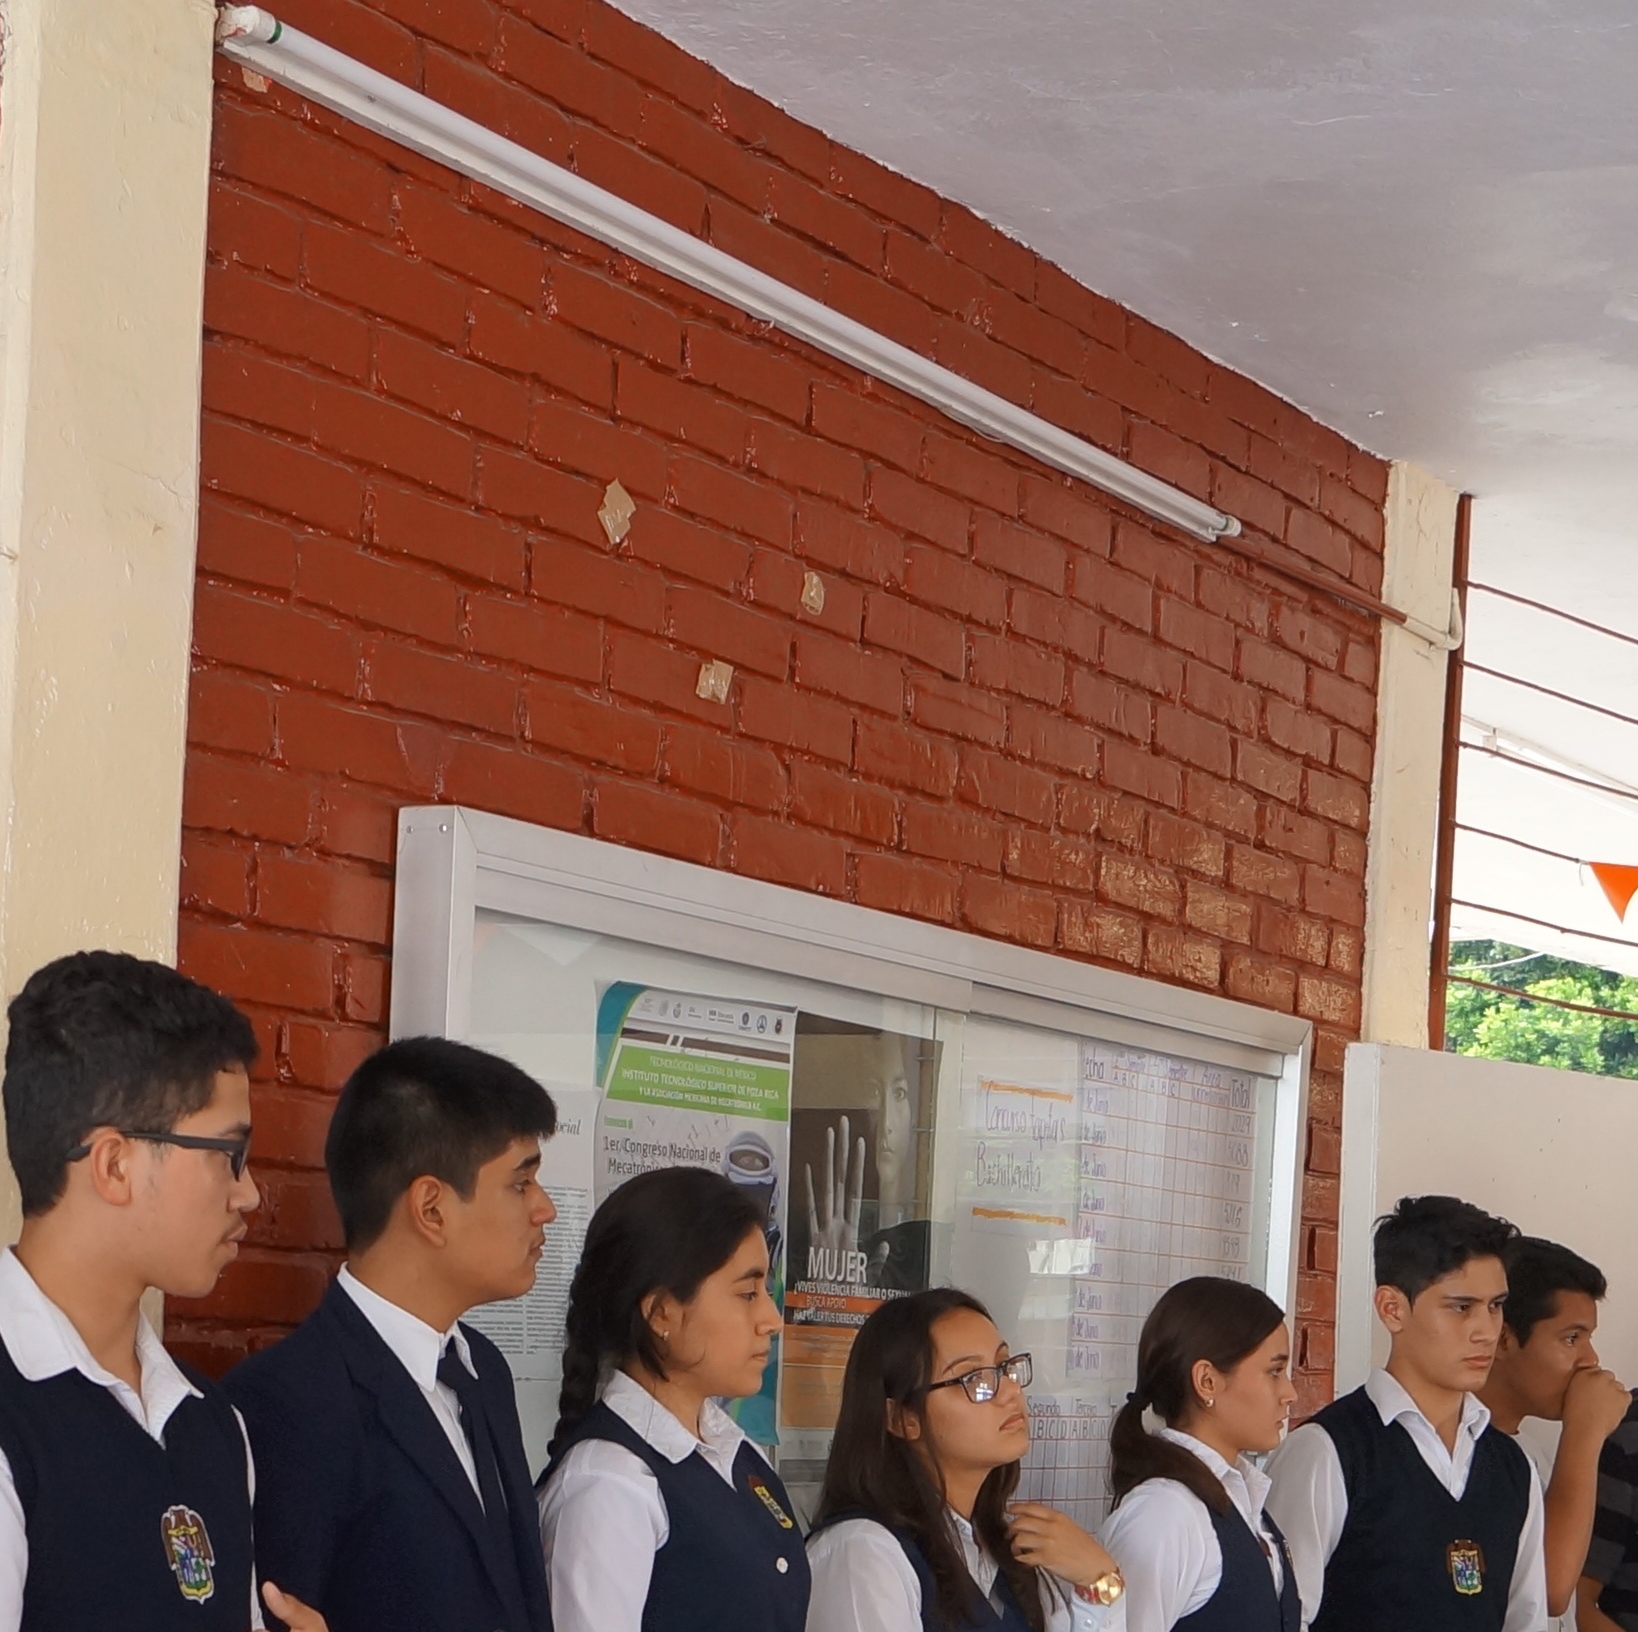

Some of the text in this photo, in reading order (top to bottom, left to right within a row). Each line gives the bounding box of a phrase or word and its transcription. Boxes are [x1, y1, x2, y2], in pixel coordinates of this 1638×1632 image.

[622, 1069, 658, 1082] INSTITUTO
[554, 1118, 581, 1135] ocial
[624, 1138, 668, 1157] Congreso
[670, 1144, 708, 1161] Nacional
[709, 1149, 721, 1163] de
[807, 1246, 868, 1283] MUJER
[818, 1282, 850, 1297] VIOLENCIA
[850, 1286, 880, 1299] FAMILIAR
[881, 1289, 887, 1300] O
